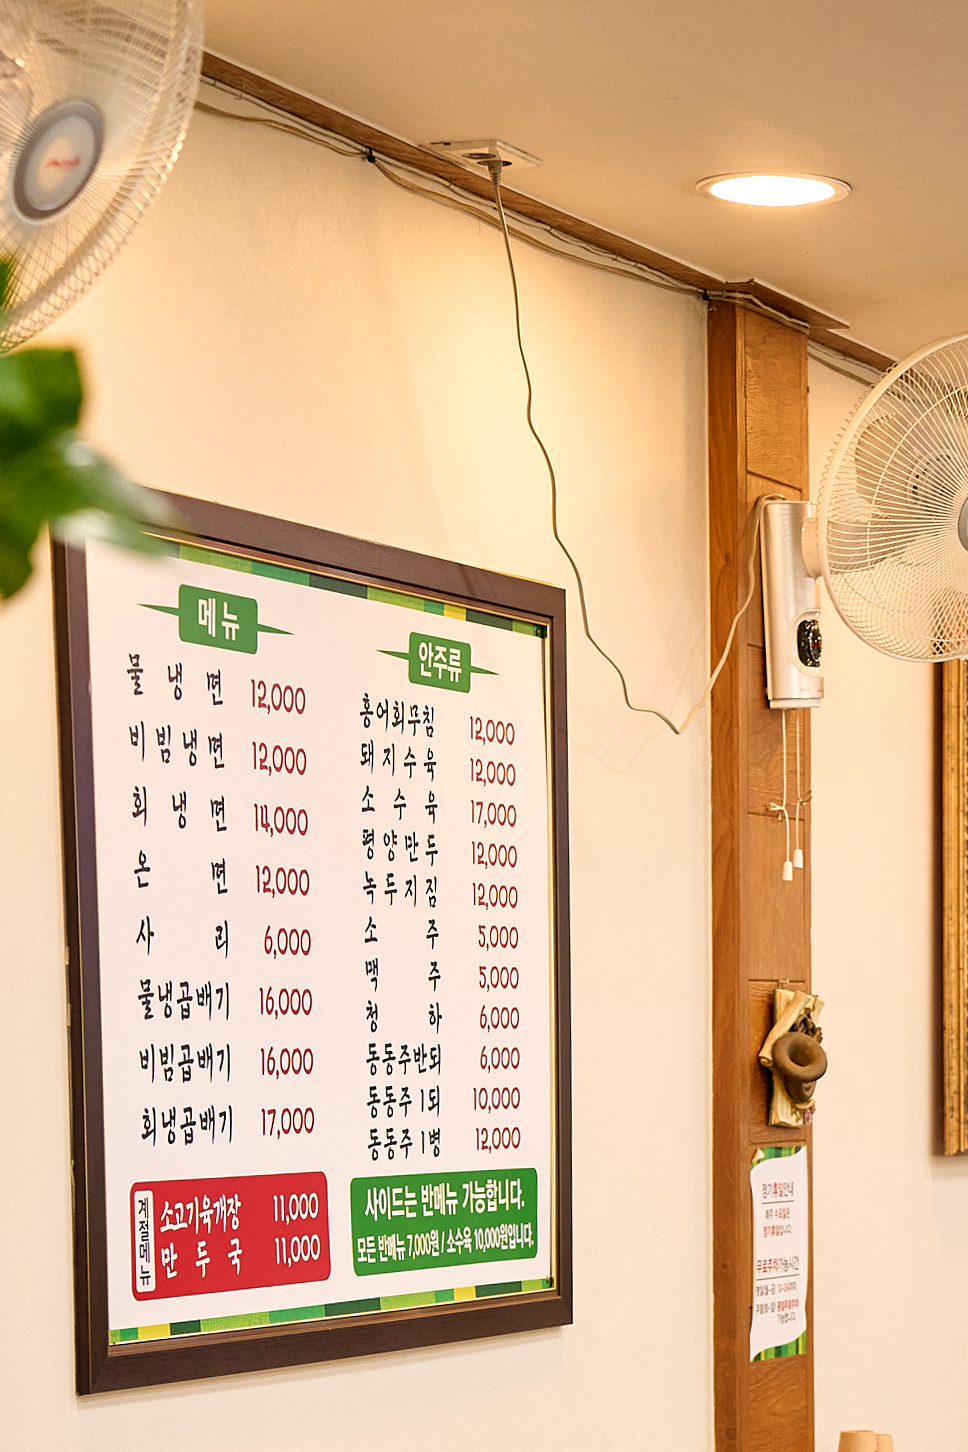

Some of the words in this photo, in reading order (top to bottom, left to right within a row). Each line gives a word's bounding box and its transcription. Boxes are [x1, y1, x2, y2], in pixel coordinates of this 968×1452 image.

[198, 597, 240, 638] 메뉴
[419, 641, 462, 683] 안주류
[251, 679, 305, 714] 12,000
[360, 693, 434, 738] 홍어회무침
[470, 716, 515, 745] 12,000
[252, 742, 306, 776] 12,000
[470, 758, 515, 787] 12,000
[254, 804, 308, 837] 14,000
[471, 800, 516, 828] 17,000
[472, 841, 517, 869] 12,000
[256, 865, 309, 898] 12,000
[473, 883, 518, 910] 12,000
[264, 926, 311, 959] 6,000
[479, 925, 518, 951] 5,000
[479, 966, 519, 992] 5,000
[138, 979, 229, 1020] 물냉곱배기
[259, 986, 312, 1019] 16,000
[480, 1005, 519, 1032] 6,000
[139, 1043, 230, 1083] 비빔곱배기
[261, 1046, 313, 1079] 16,000
[480, 1046, 520, 1073] 6,000
[367, 1086, 412, 1118] 동동주
[473, 1087, 520, 1113] 10,000
[141, 1105, 232, 1146] 회냉곱배기
[262, 1107, 314, 1139] 17,000
[368, 1128, 412, 1161] 동동주
[476, 1127, 520, 1153] 12,000
[161, 1194, 241, 1234] 소고기육개장
[274, 1193, 318, 1225] 11,000
[365, 1186, 417, 1221] 사이드는
[421, 1183, 458, 1217] 반메뉴
[462, 1178, 525, 1214] 가능합니다.
[138, 1197, 151, 1286] 계절메뉴
[275, 1235, 320, 1267] 11,000
[357, 1236, 376, 1263] 모든
[378, 1233, 406, 1262] 반메뉴
[407, 1229, 440, 1260] 7,000원
[447, 1226, 473, 1254] 소수육
[474, 1222, 534, 1252] 10,000원입니다.
